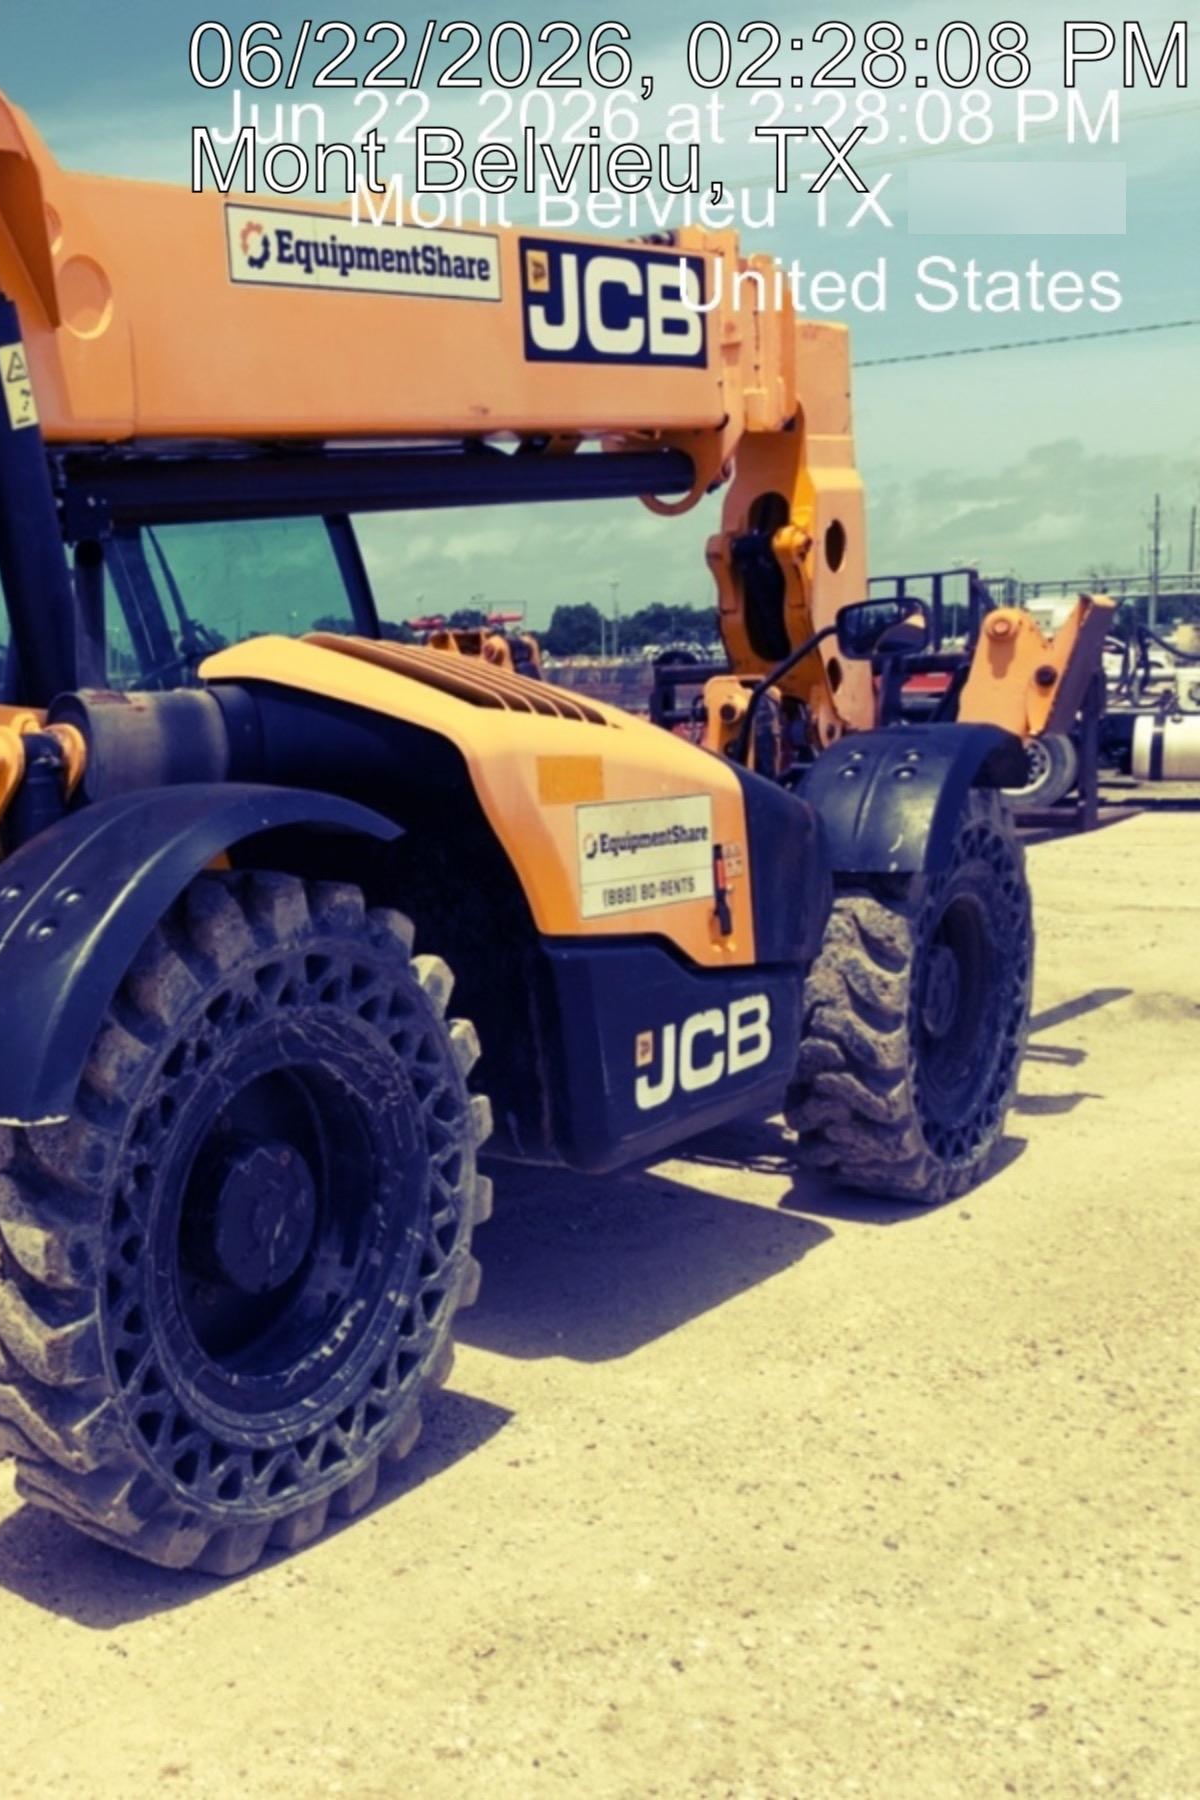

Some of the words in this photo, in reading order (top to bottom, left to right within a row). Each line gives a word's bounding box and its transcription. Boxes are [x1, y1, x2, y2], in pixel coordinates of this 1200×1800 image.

[275, 229, 491, 281] EquipmentShare
[529, 253, 702, 356] JCB
[599, 825, 709, 857] EquipmentShare
[635, 993, 772, 1109] JCB
